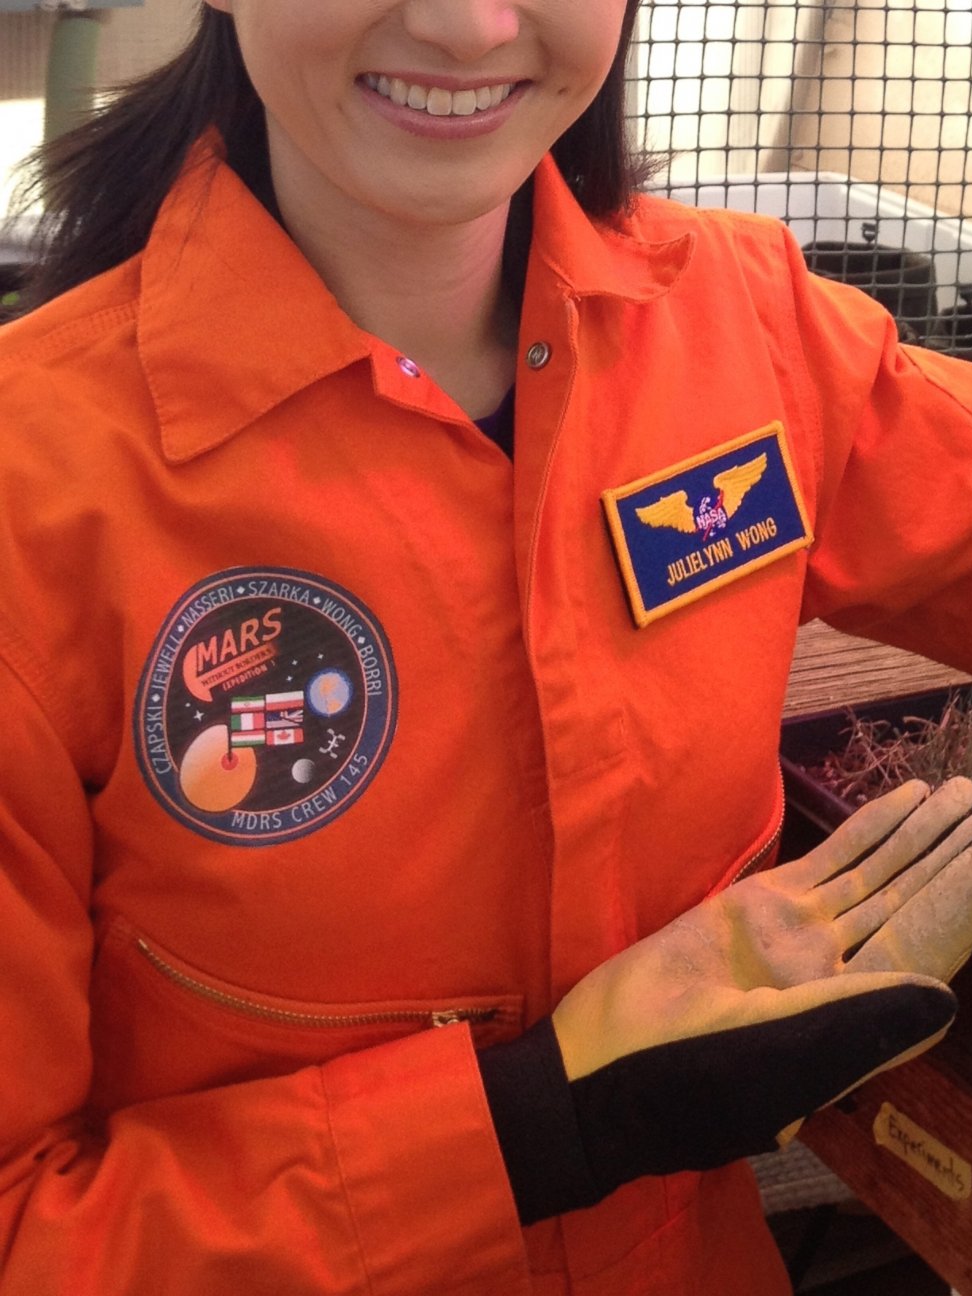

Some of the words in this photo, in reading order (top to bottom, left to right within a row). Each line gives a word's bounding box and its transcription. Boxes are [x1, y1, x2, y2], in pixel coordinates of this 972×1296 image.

[696, 508, 727, 530] NASA
[667, 538, 734, 587] JULIELYNN
[736, 517, 778, 551] WONG
[183, 586, 236, 627] NASSERI
[248, 581, 311, 605] SZARKA
[321, 598, 362, 639] WONG
[151, 634, 182, 691] JEWELL
[196, 607, 282, 671] MARS
[358, 645, 382, 697] BORRI
[147, 706, 172, 774] CZAPSKI
[232, 811, 283, 830] MDRS
[291, 789, 337, 823] CREW
[340, 753, 368, 786] 145
